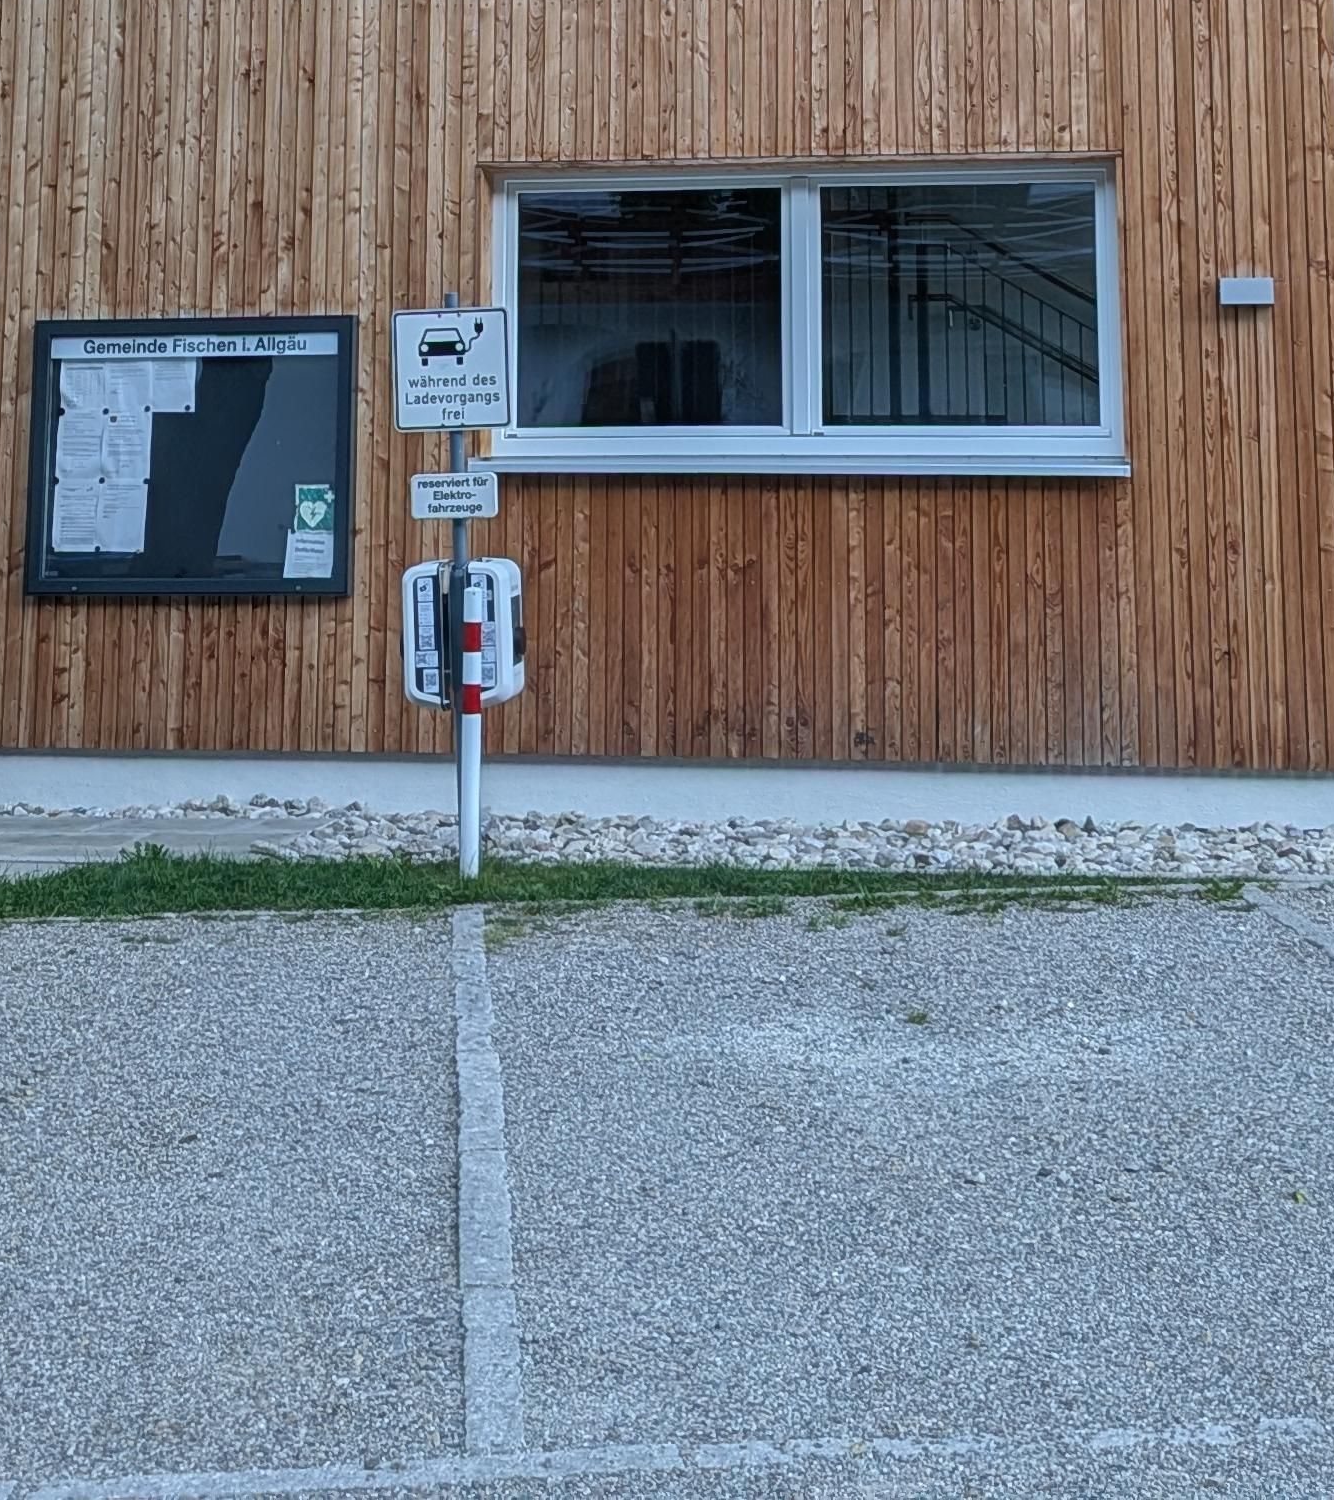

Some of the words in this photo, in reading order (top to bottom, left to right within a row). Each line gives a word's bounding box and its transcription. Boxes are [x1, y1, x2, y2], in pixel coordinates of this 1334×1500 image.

[83, 339, 168, 355] Gemeinde
[172, 338, 237, 353] Fischen
[242, 338, 251, 353] i.
[255, 336, 307, 355] Allgäu
[408, 374, 467, 388] während
[472, 373, 497, 386] des
[405, 392, 501, 406] Ladevorgangs
[441, 407, 465, 420] frei
[417, 478, 470, 489] reserviert
[473, 477, 489, 487] für
[433, 490, 477, 500] Elektro-
[427, 503, 483, 515] fahrzeuge
